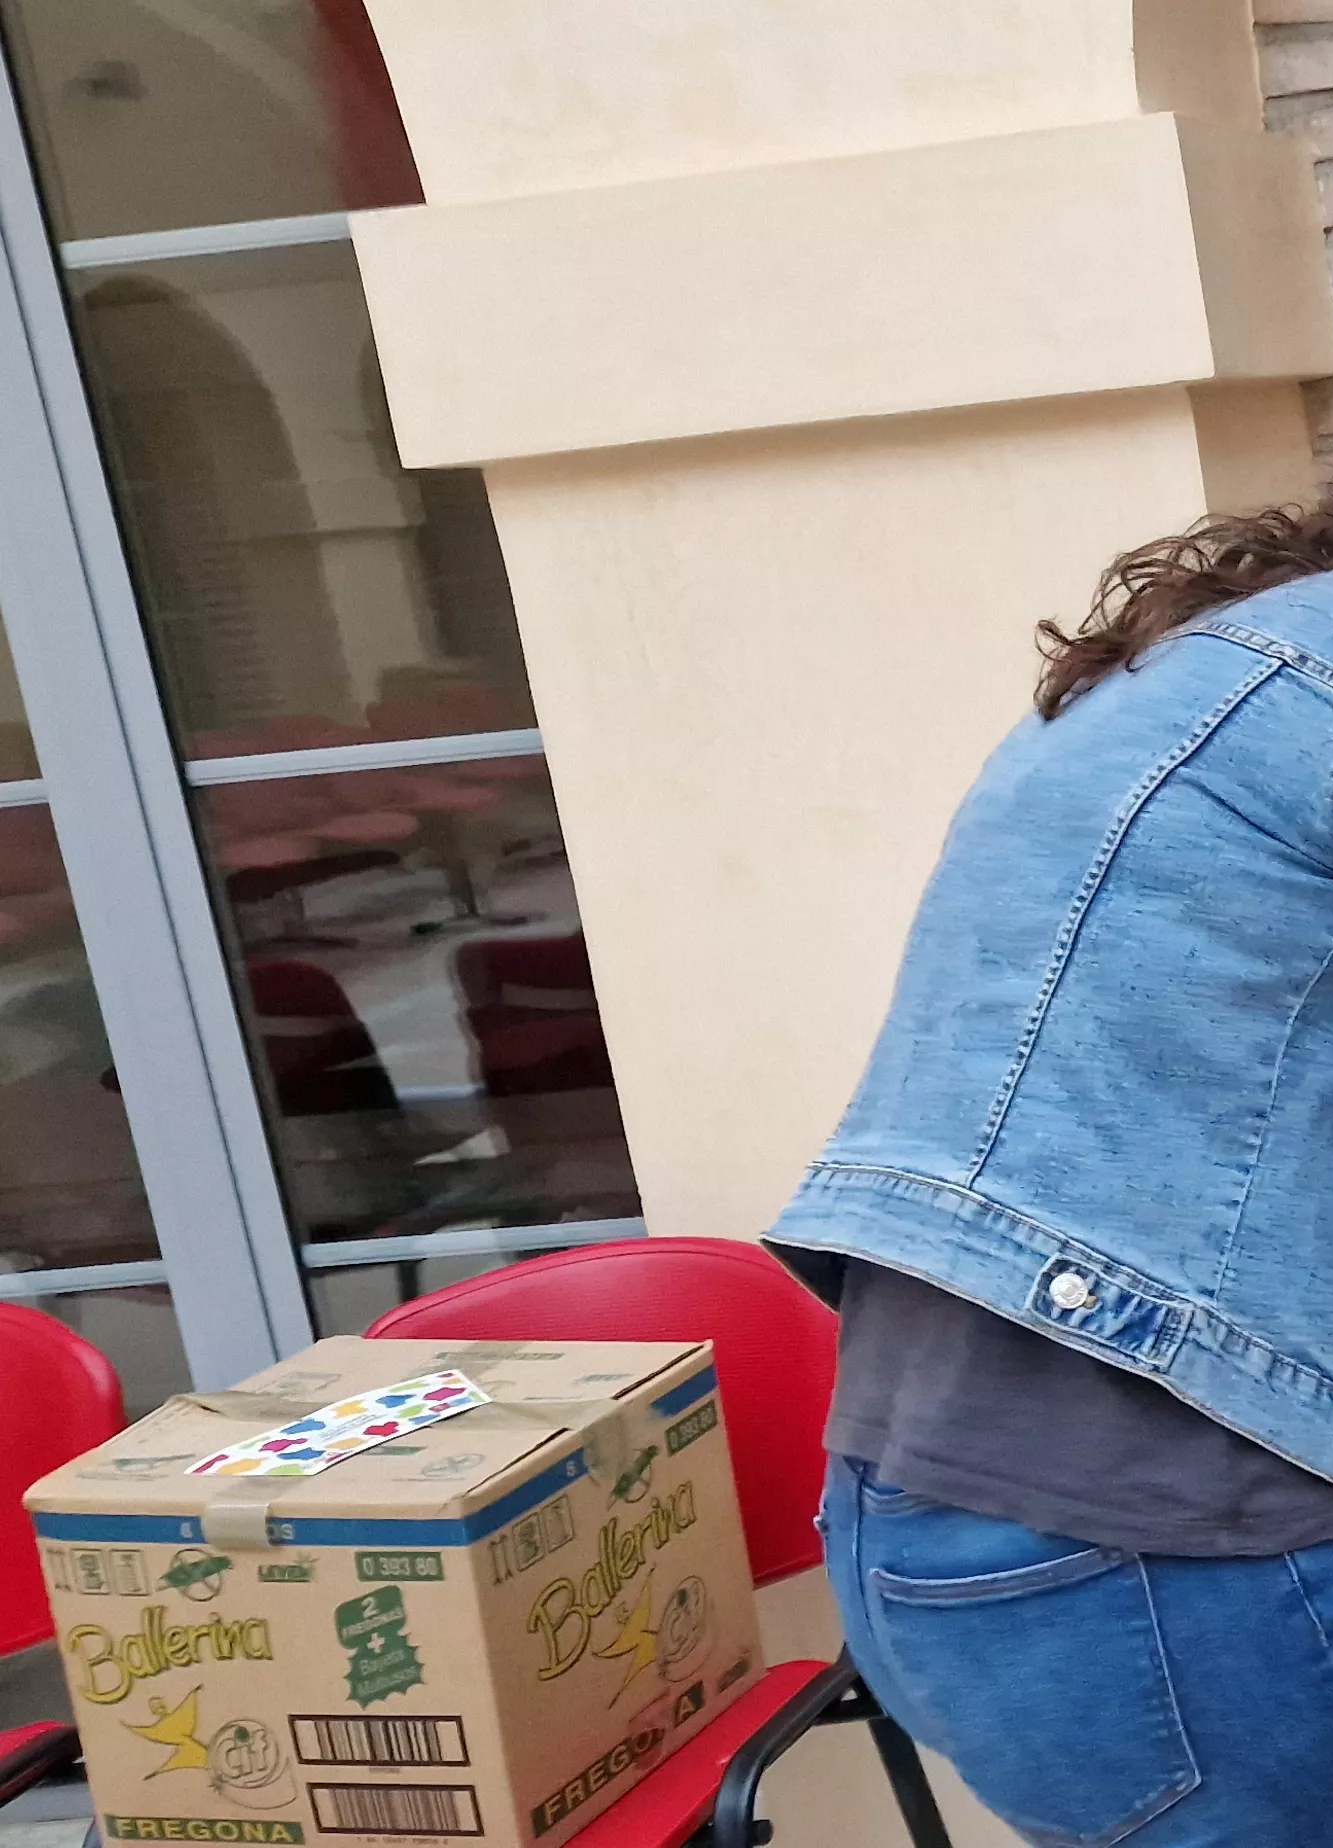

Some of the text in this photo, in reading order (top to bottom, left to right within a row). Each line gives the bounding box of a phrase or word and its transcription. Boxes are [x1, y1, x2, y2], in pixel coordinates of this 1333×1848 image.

[361, 1596, 378, 1618] 2
[526, 1480, 697, 1682] Ballerina
[66, 1604, 274, 1705] Ballerina
[542, 1693, 697, 1830] FREGOA
[113, 1817, 296, 1845] FREGONA
